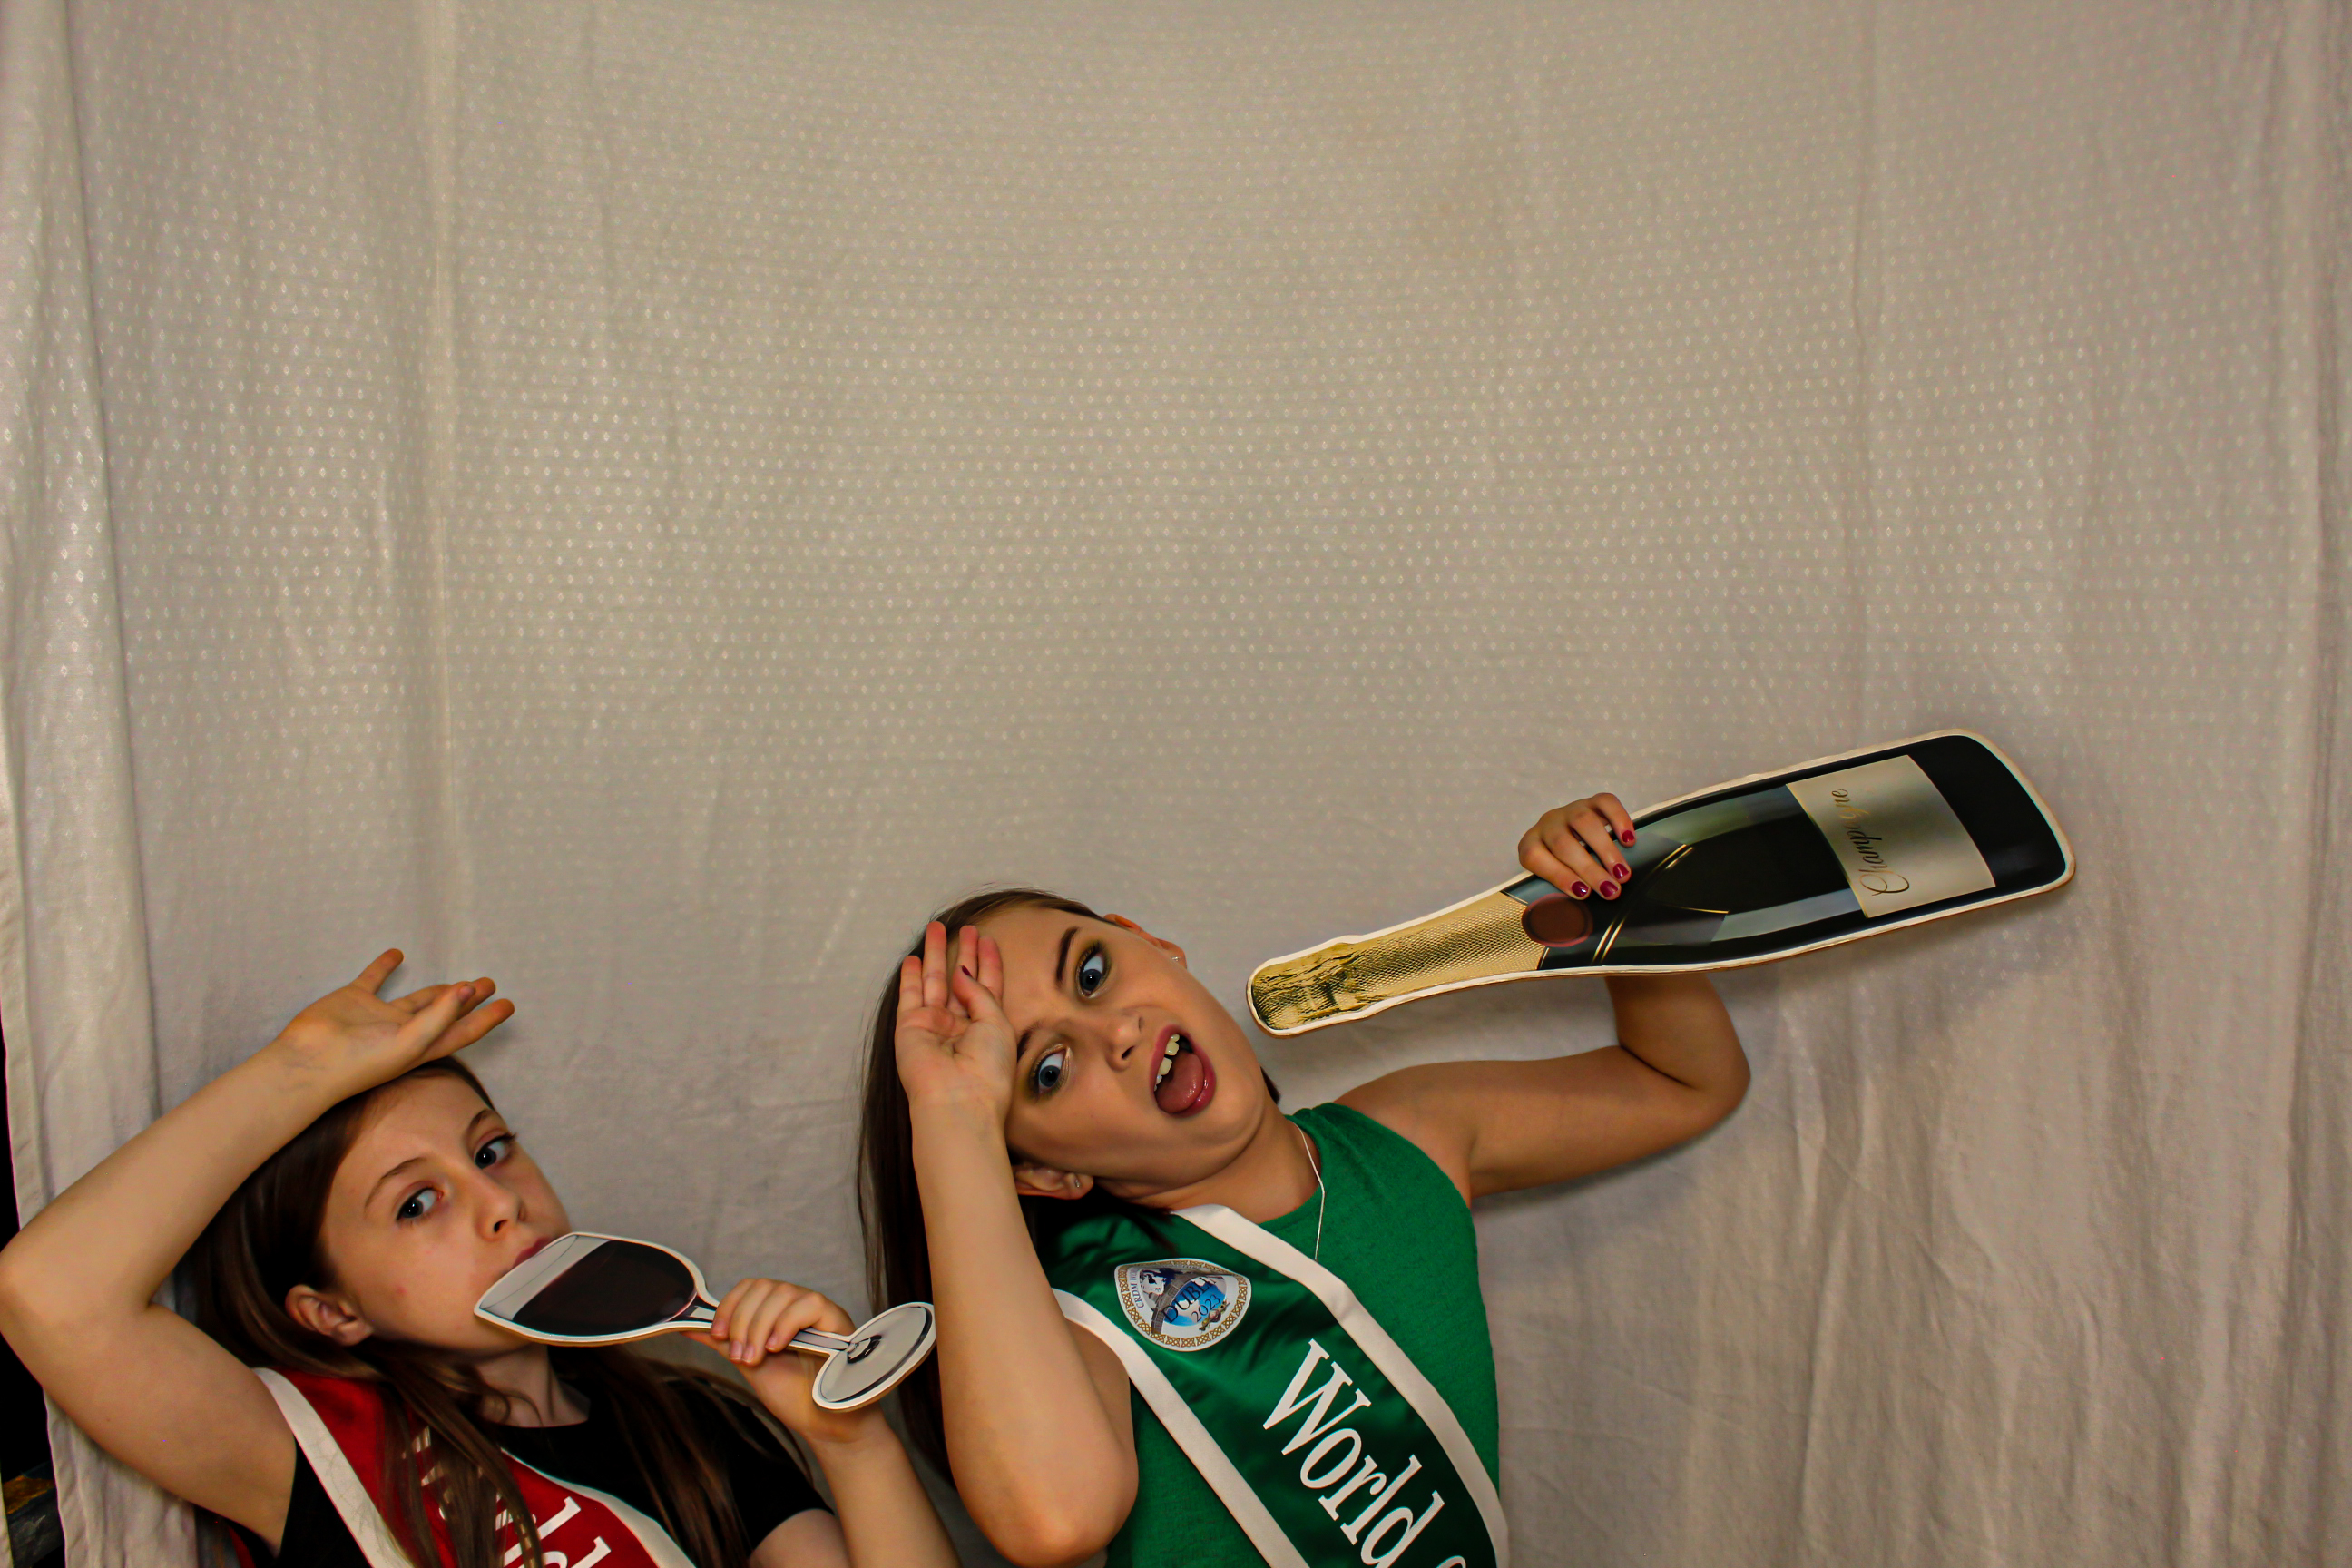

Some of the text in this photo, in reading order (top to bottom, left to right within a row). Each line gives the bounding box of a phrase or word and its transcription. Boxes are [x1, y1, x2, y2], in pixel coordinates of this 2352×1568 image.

[1831, 789, 1910, 897] Champagne
[1130, 1283, 1144, 1308] CRDM
[1191, 1293, 1220, 1322] 2023
[1263, 1338, 1445, 1568] World
